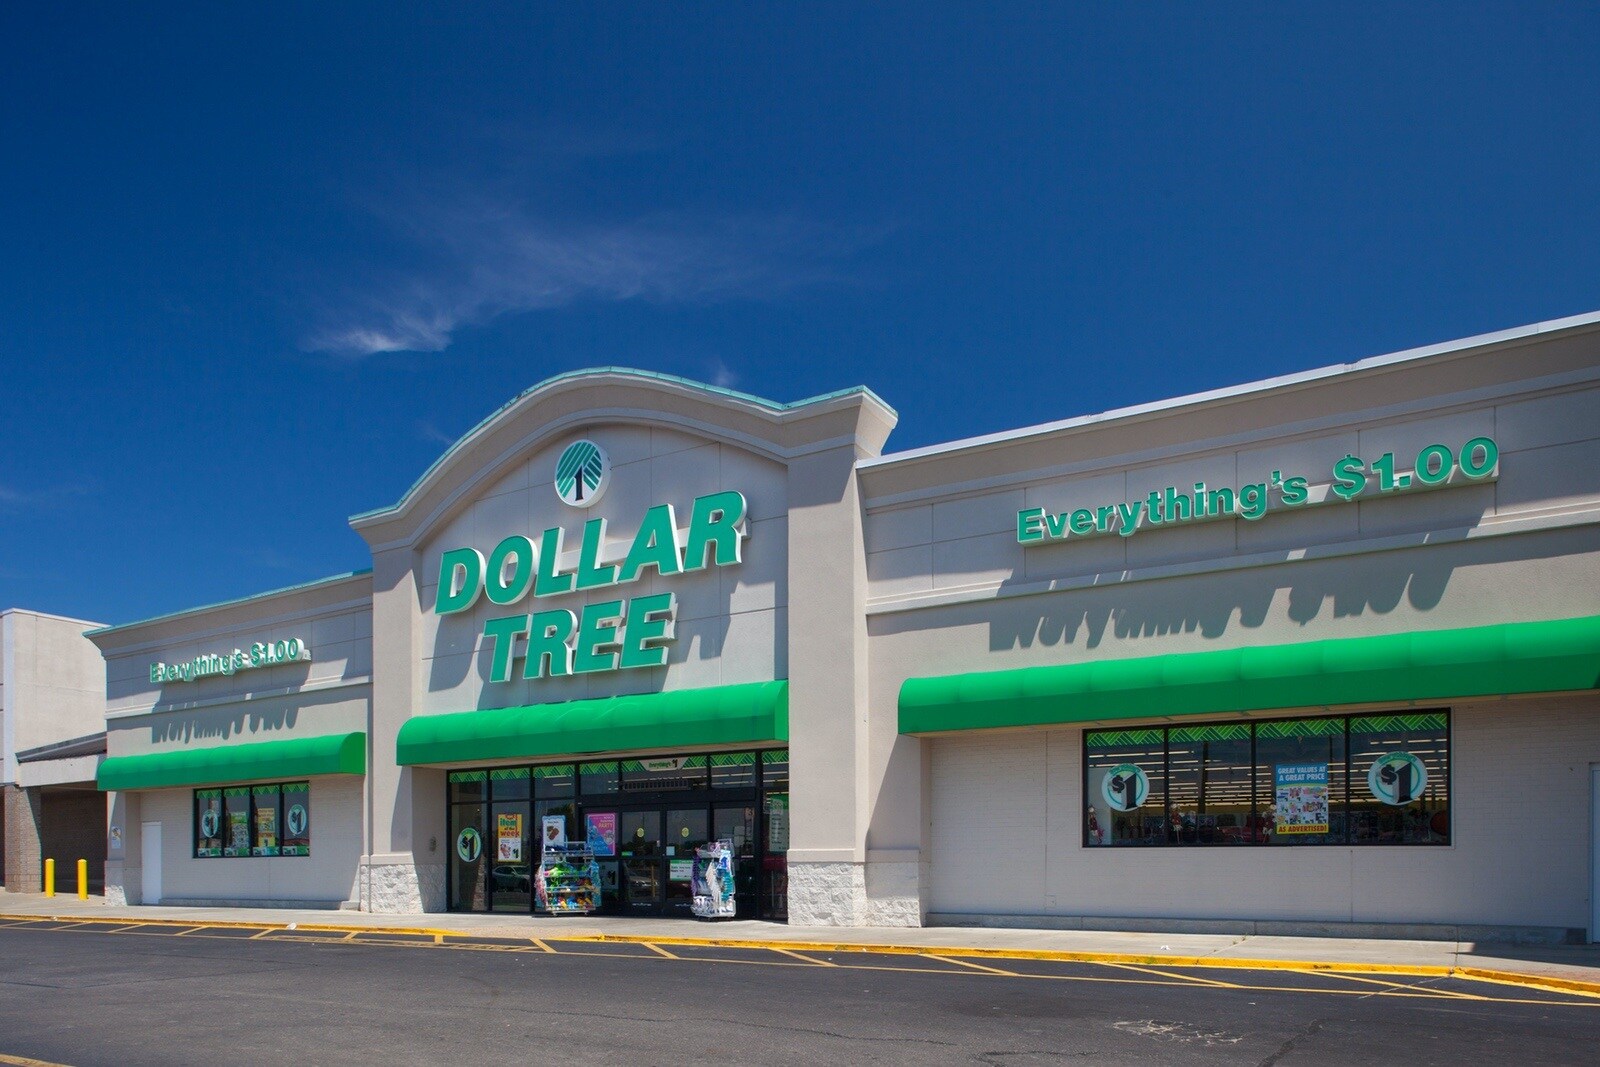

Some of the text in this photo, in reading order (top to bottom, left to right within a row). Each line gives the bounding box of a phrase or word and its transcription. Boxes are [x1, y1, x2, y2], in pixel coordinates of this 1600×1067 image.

[1016, 436, 1501, 547] Everything's $1.00
[434, 490, 748, 616] DOLLAR
[482, 591, 678, 683] TREE
[250, 637, 304, 668] $1.00
[1277, 767, 1296, 775] GREAT
[1297, 766, 1318, 774] VALUES
[1285, 774, 1306, 782] GREAT
[500, 829, 520, 838] week
[1287, 825, 1327, 833] ADVERTISED!
